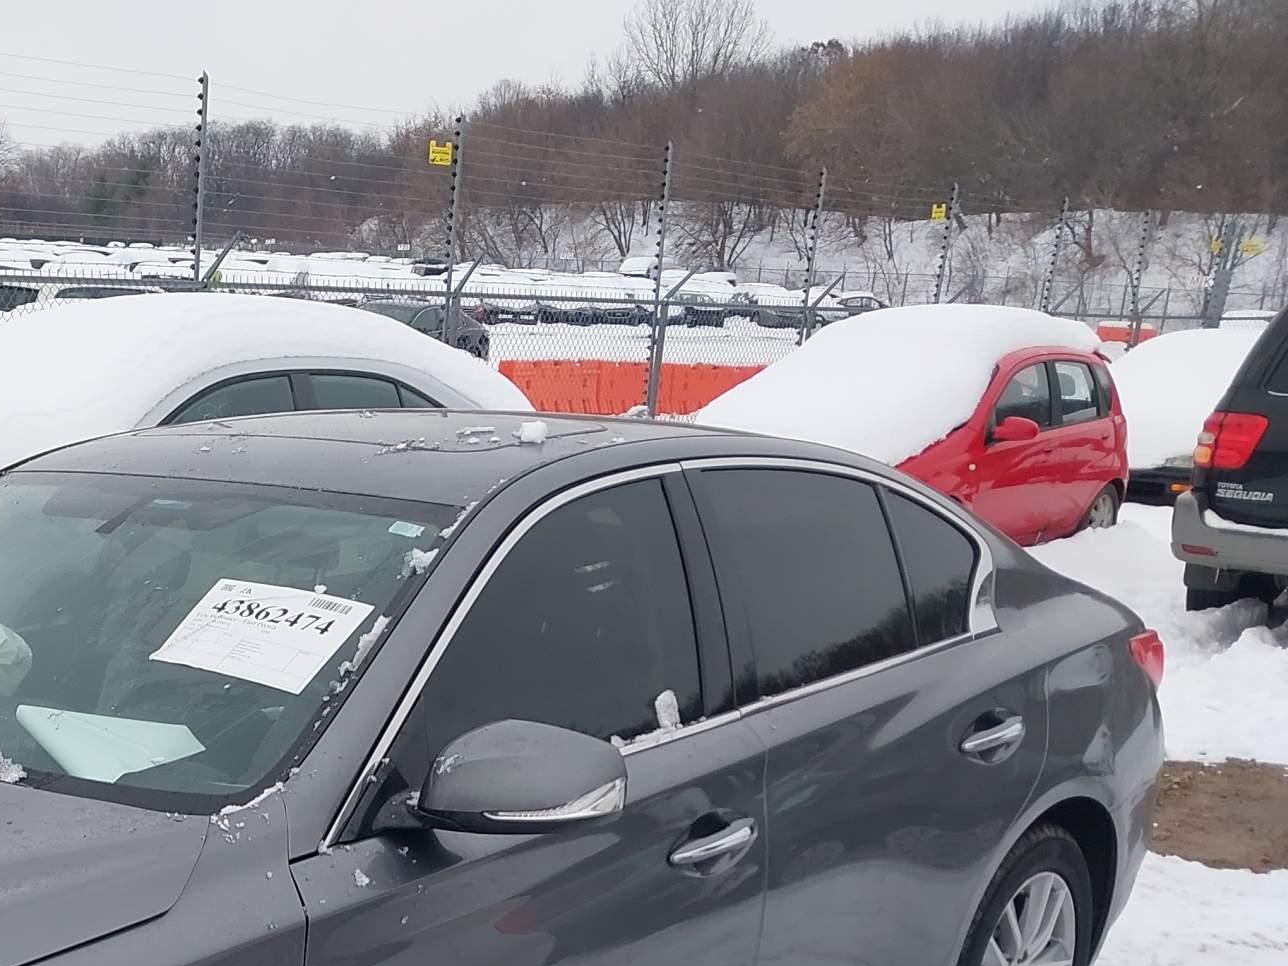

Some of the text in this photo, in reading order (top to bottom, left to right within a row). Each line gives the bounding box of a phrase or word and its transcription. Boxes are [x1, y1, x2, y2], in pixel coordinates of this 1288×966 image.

[1216, 481, 1243, 490] TOYOTA
[1215, 488, 1274, 502] SEQUOIA
[211, 598, 336, 636] 43862474
